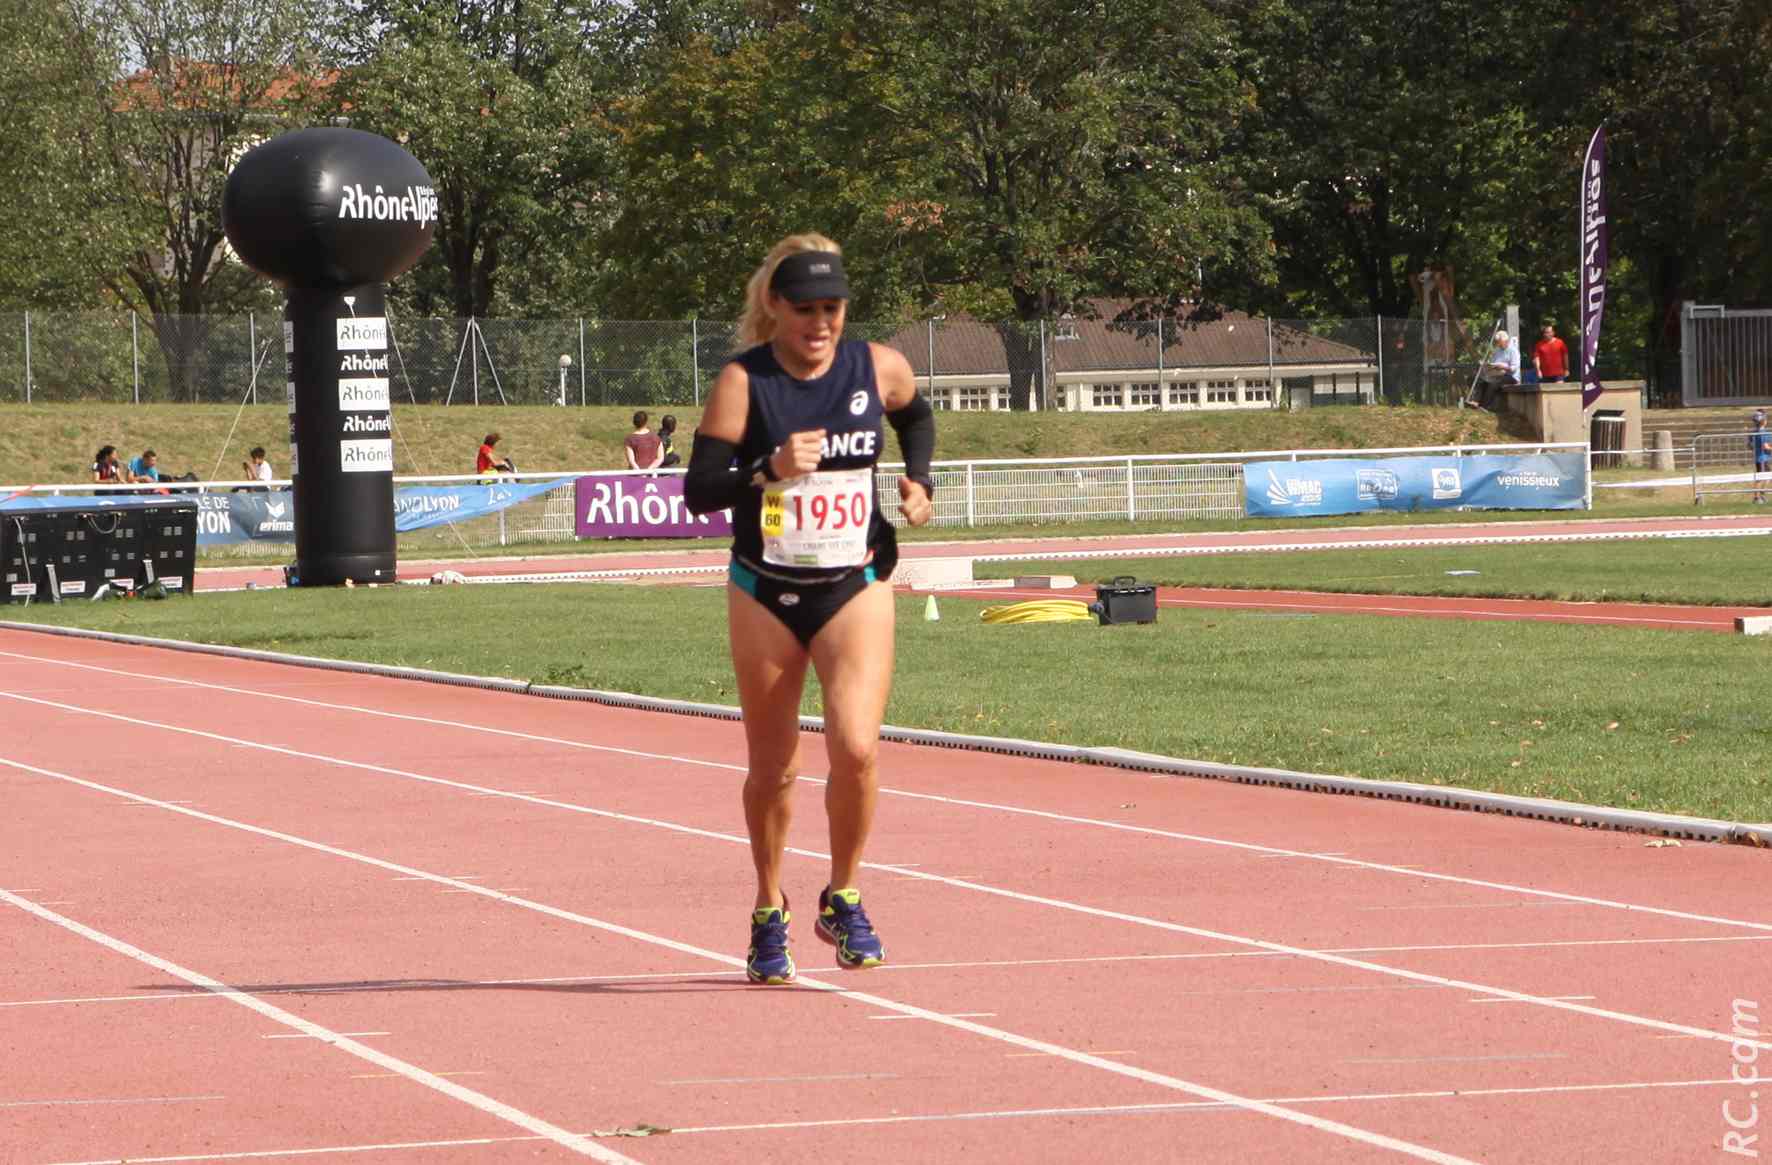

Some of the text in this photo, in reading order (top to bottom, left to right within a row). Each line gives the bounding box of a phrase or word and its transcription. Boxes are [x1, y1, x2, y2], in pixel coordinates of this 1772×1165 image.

[820, 431, 876, 459] ANCE
[213, 497, 230, 509] DE
[586, 480, 733, 525] Rhôn
[766, 495, 781, 508] W
[792, 492, 867, 531] 1950
[196, 511, 231, 534] YON
